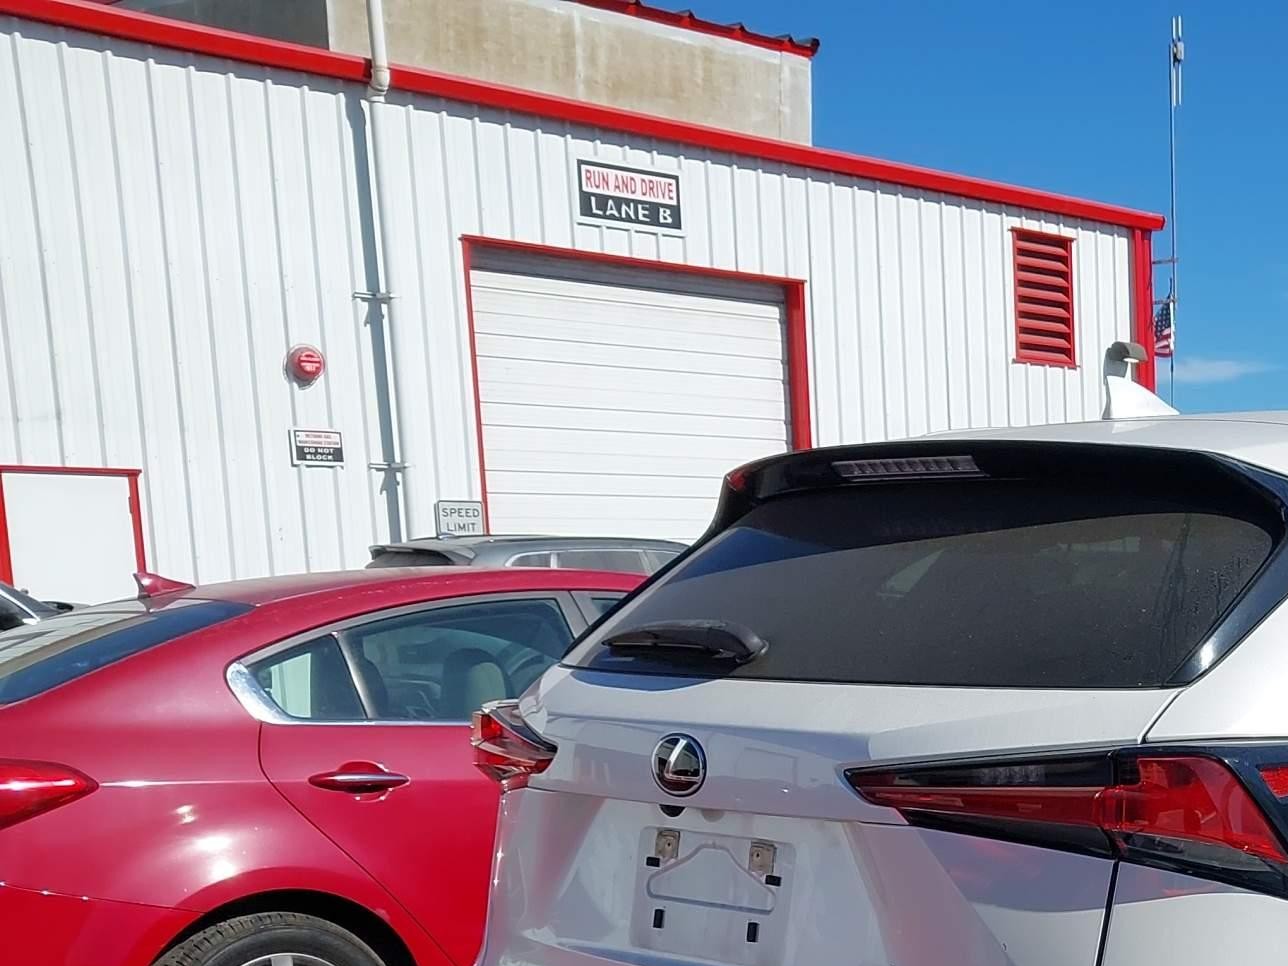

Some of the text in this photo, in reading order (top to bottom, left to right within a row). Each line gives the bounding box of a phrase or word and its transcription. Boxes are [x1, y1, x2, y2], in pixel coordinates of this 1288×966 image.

[585, 169, 674, 200] RUN AND DRIVE
[590, 196, 673, 224] LANE B
[441, 507, 480, 518] SPEED
[446, 522, 476, 532] LIMIT
